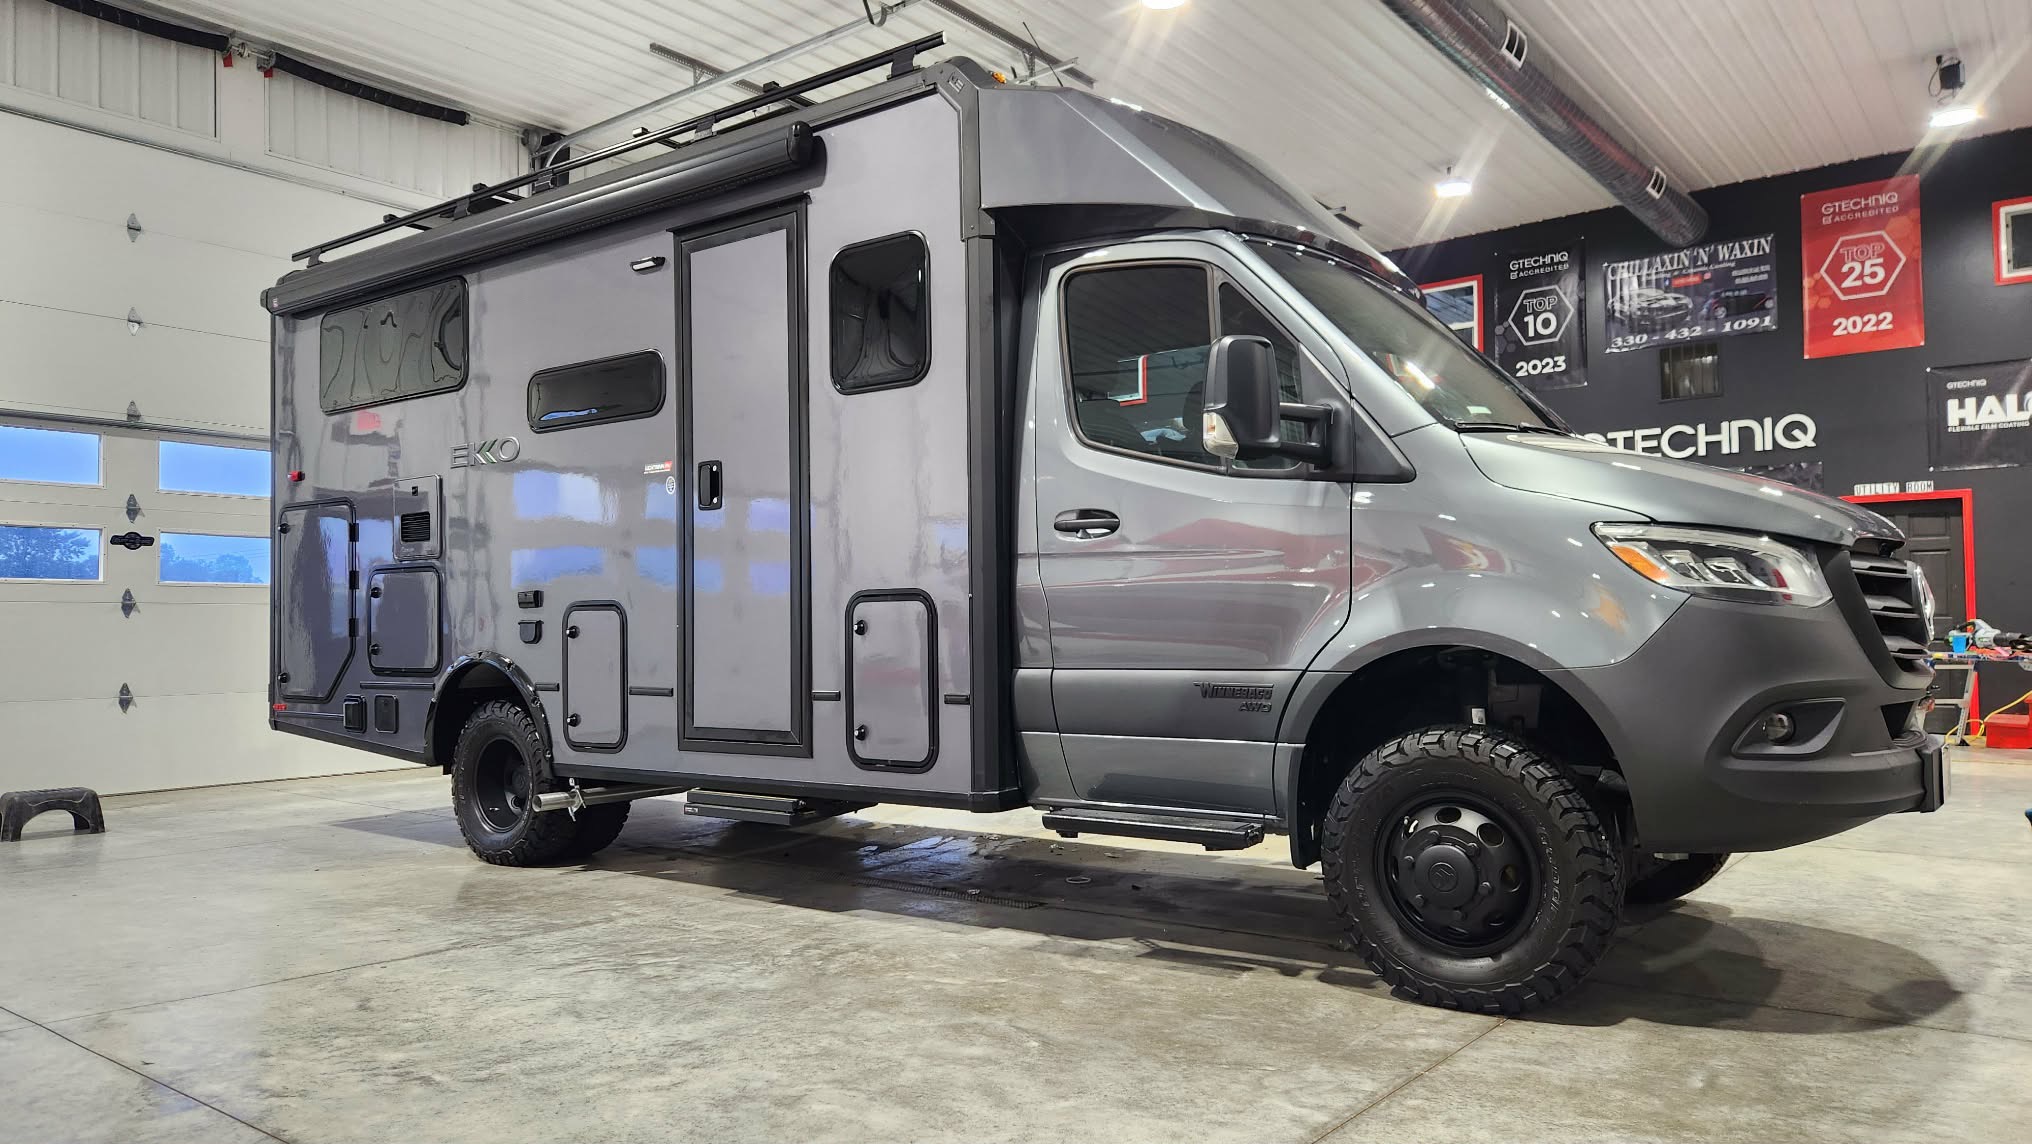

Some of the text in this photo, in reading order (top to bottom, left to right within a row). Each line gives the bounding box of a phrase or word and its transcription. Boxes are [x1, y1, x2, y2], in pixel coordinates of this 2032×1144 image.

[1821, 192, 1898, 215] GTECHNIQ
[1834, 205, 1899, 223] ACCREDITED
[1509, 251, 1569, 271] GTECHNIQ
[1840, 243, 1884, 263] TOP
[1518, 263, 1569, 278] ACCREDITED
[1608, 251, 1691, 280] CHILLAXIN
[1840, 258, 1886, 288] 25
[1523, 296, 1558, 314] TOP
[1523, 311, 1558, 337] 10
[1611, 333, 1648, 348] 330
[1664, 326, 1702, 340] 432
[1721, 316, 1772, 333] 1091
[1832, 312, 1894, 336] 2022
[1515, 355, 1567, 377] 2023
[1947, 391, 2032, 426] HAL
[450, 436, 521, 469] EKKO
[1905, 480, 1934, 493] ROOM
[1194, 681, 1275, 700] WINNEBAGO
[1239, 701, 1273, 713] AWD
